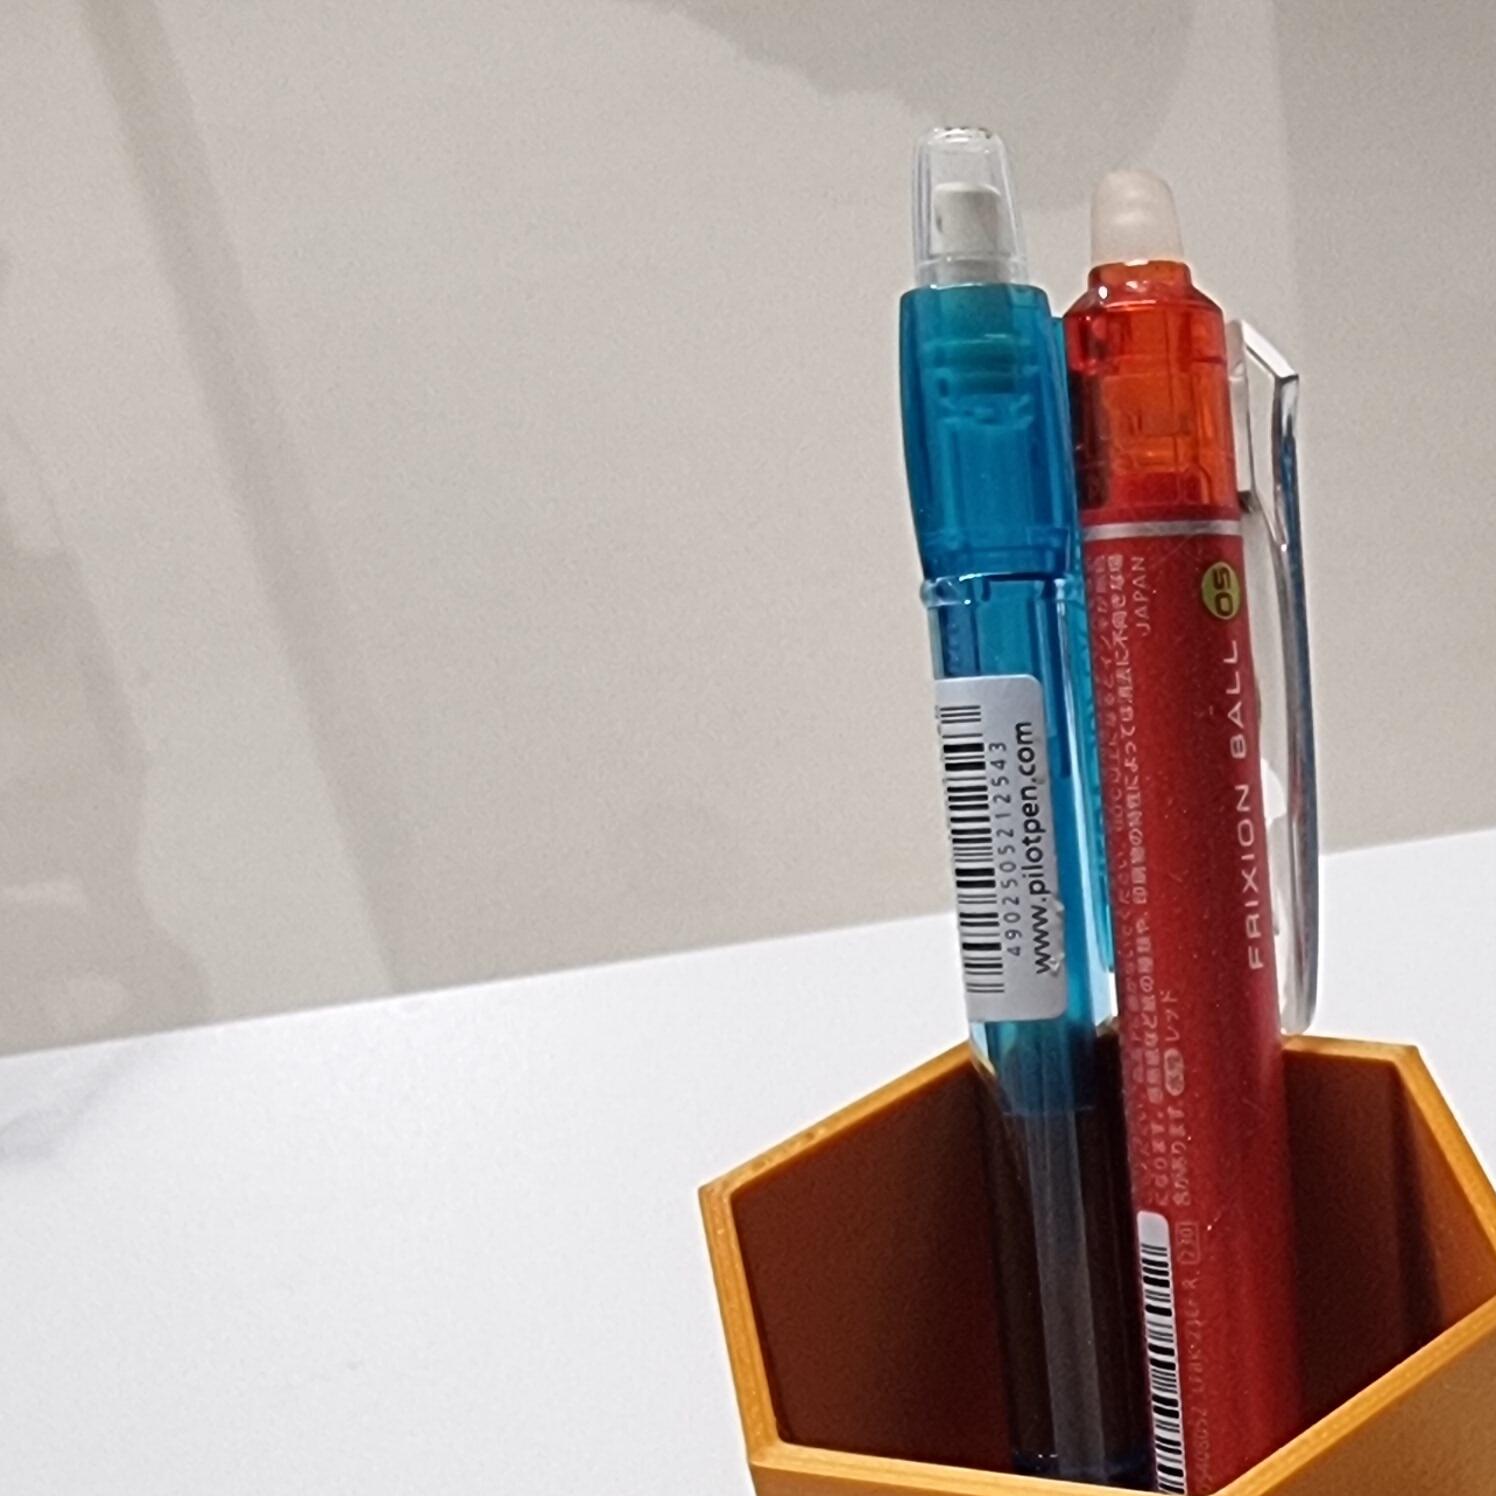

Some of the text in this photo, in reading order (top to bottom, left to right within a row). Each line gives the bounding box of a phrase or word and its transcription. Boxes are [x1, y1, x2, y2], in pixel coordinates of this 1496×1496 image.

[1131, 556, 1150, 637] JAPAN
[1212, 566, 1235, 617] 05
[988, 741, 1023, 957] 4902505212543
[1014, 721, 1053, 975] www.pilotpen.com
[1223, 640, 1264, 970] FRIXION BALL
